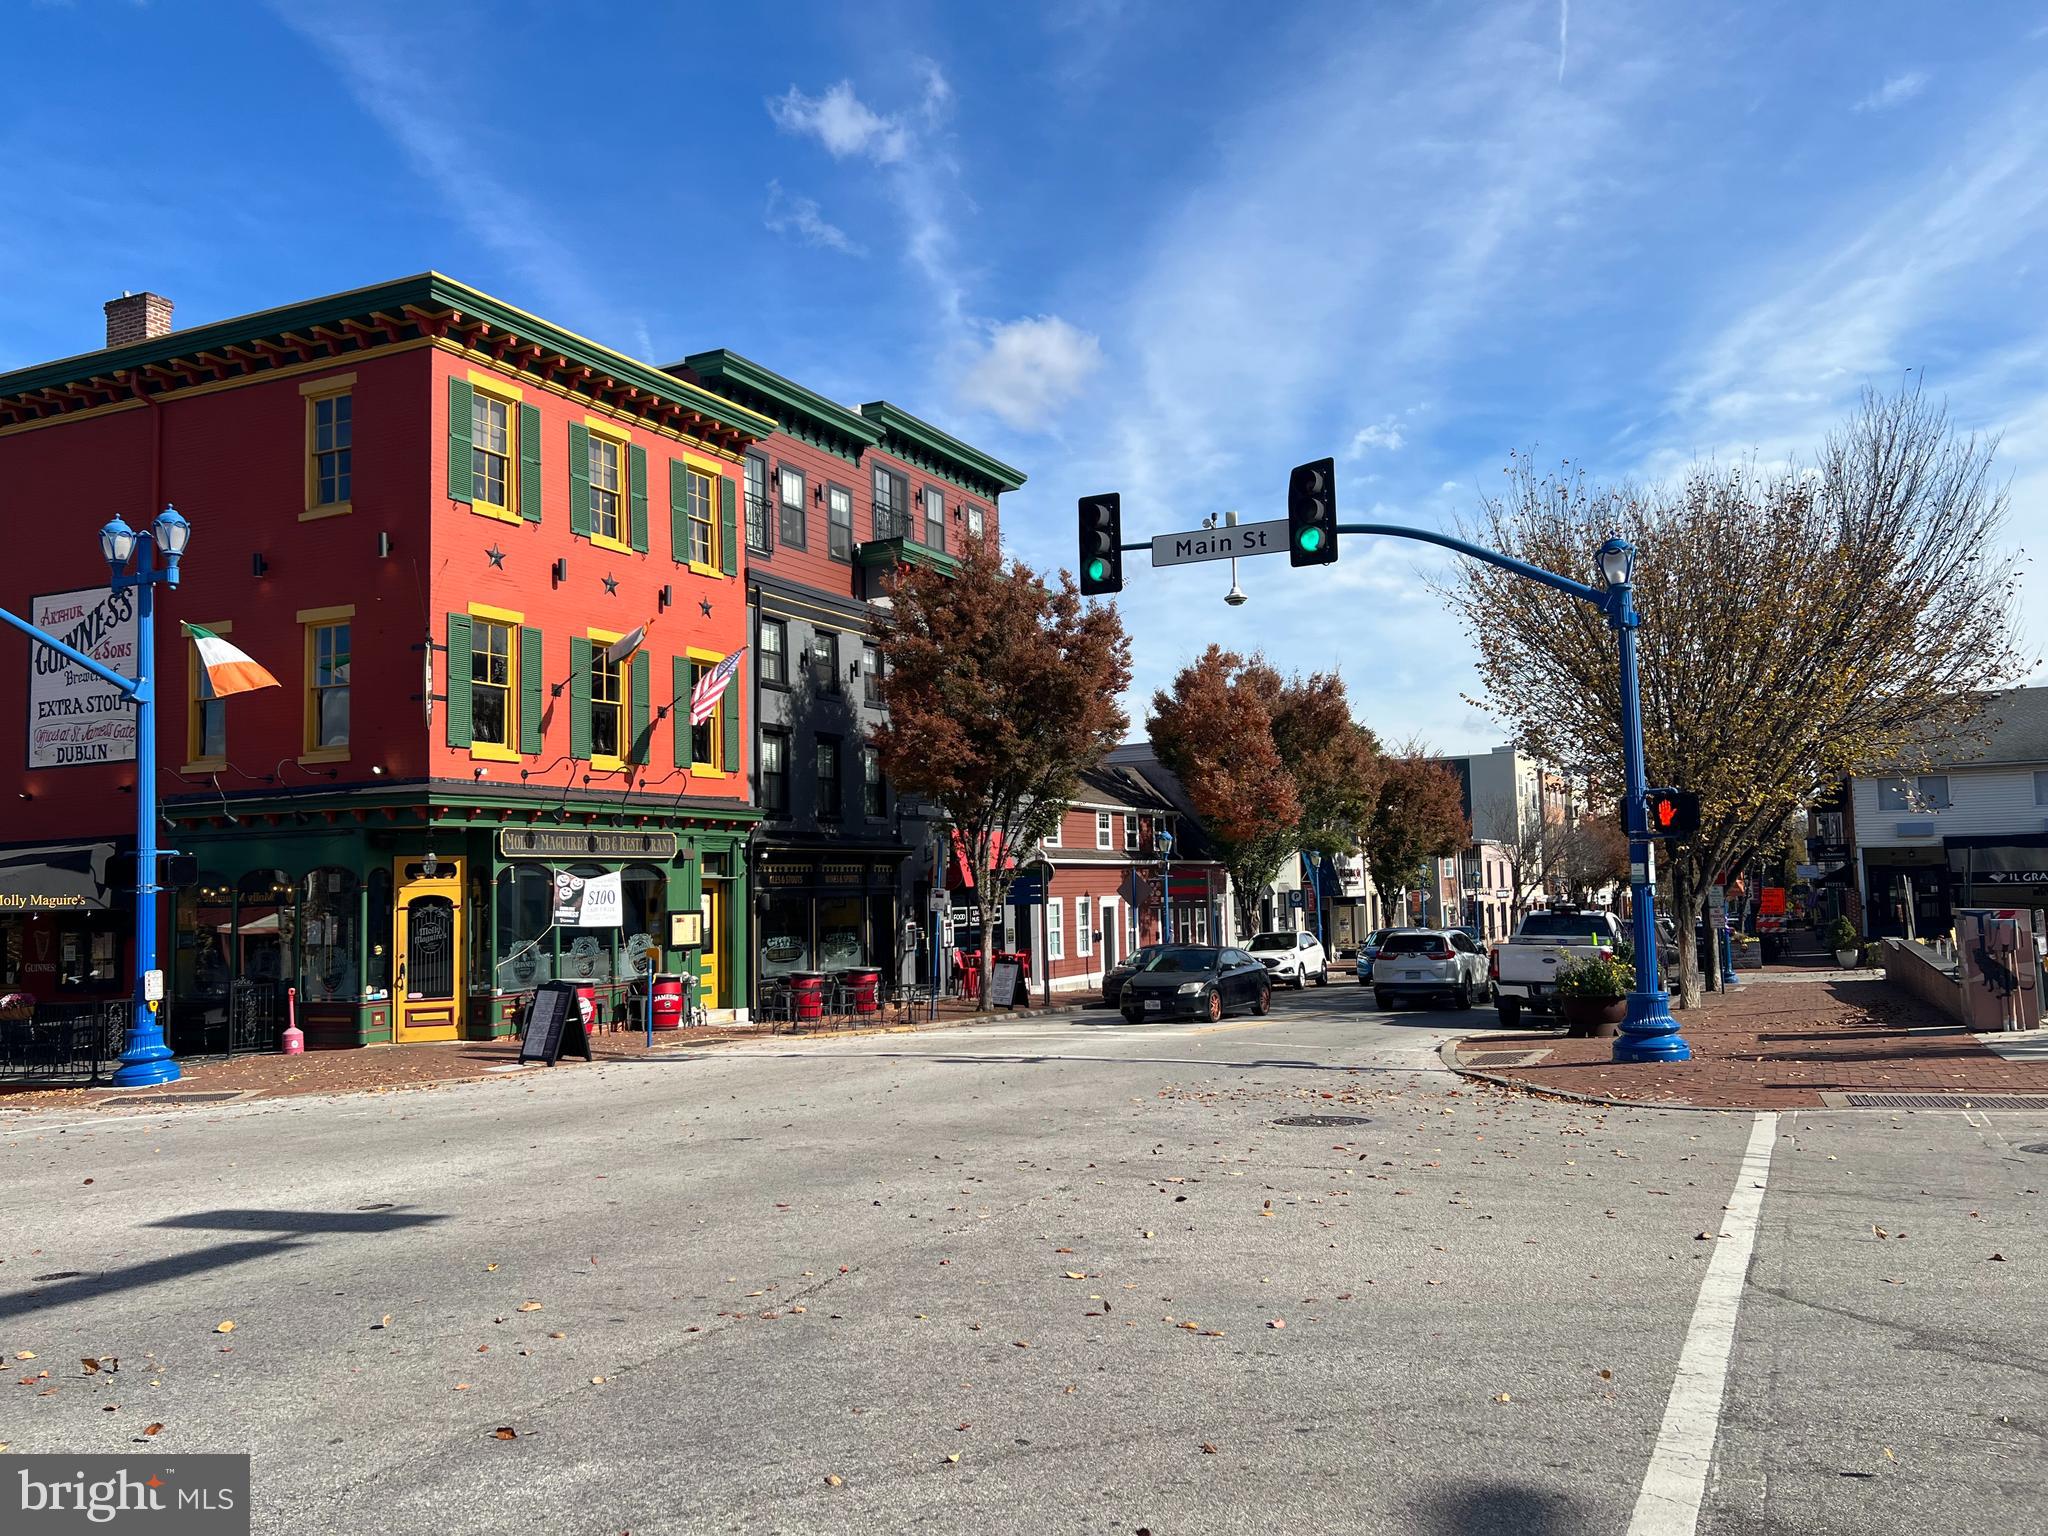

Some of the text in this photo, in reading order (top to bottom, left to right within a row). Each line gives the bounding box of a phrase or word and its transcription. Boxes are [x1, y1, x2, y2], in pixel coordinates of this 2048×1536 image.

[1176, 530, 1267, 557] Main St
[38, 698, 84, 720] EXTRA
[56, 743, 108, 764] DUBLIN
[541, 834, 589, 851] MAGUIRE'S
[2009, 872, 2020, 881] IL
[30, 894, 86, 908] Maguire's
[587, 889, 616, 906] $100
[953, 913, 966, 921] FOOD
[654, 993, 680, 1002] JAMESON
